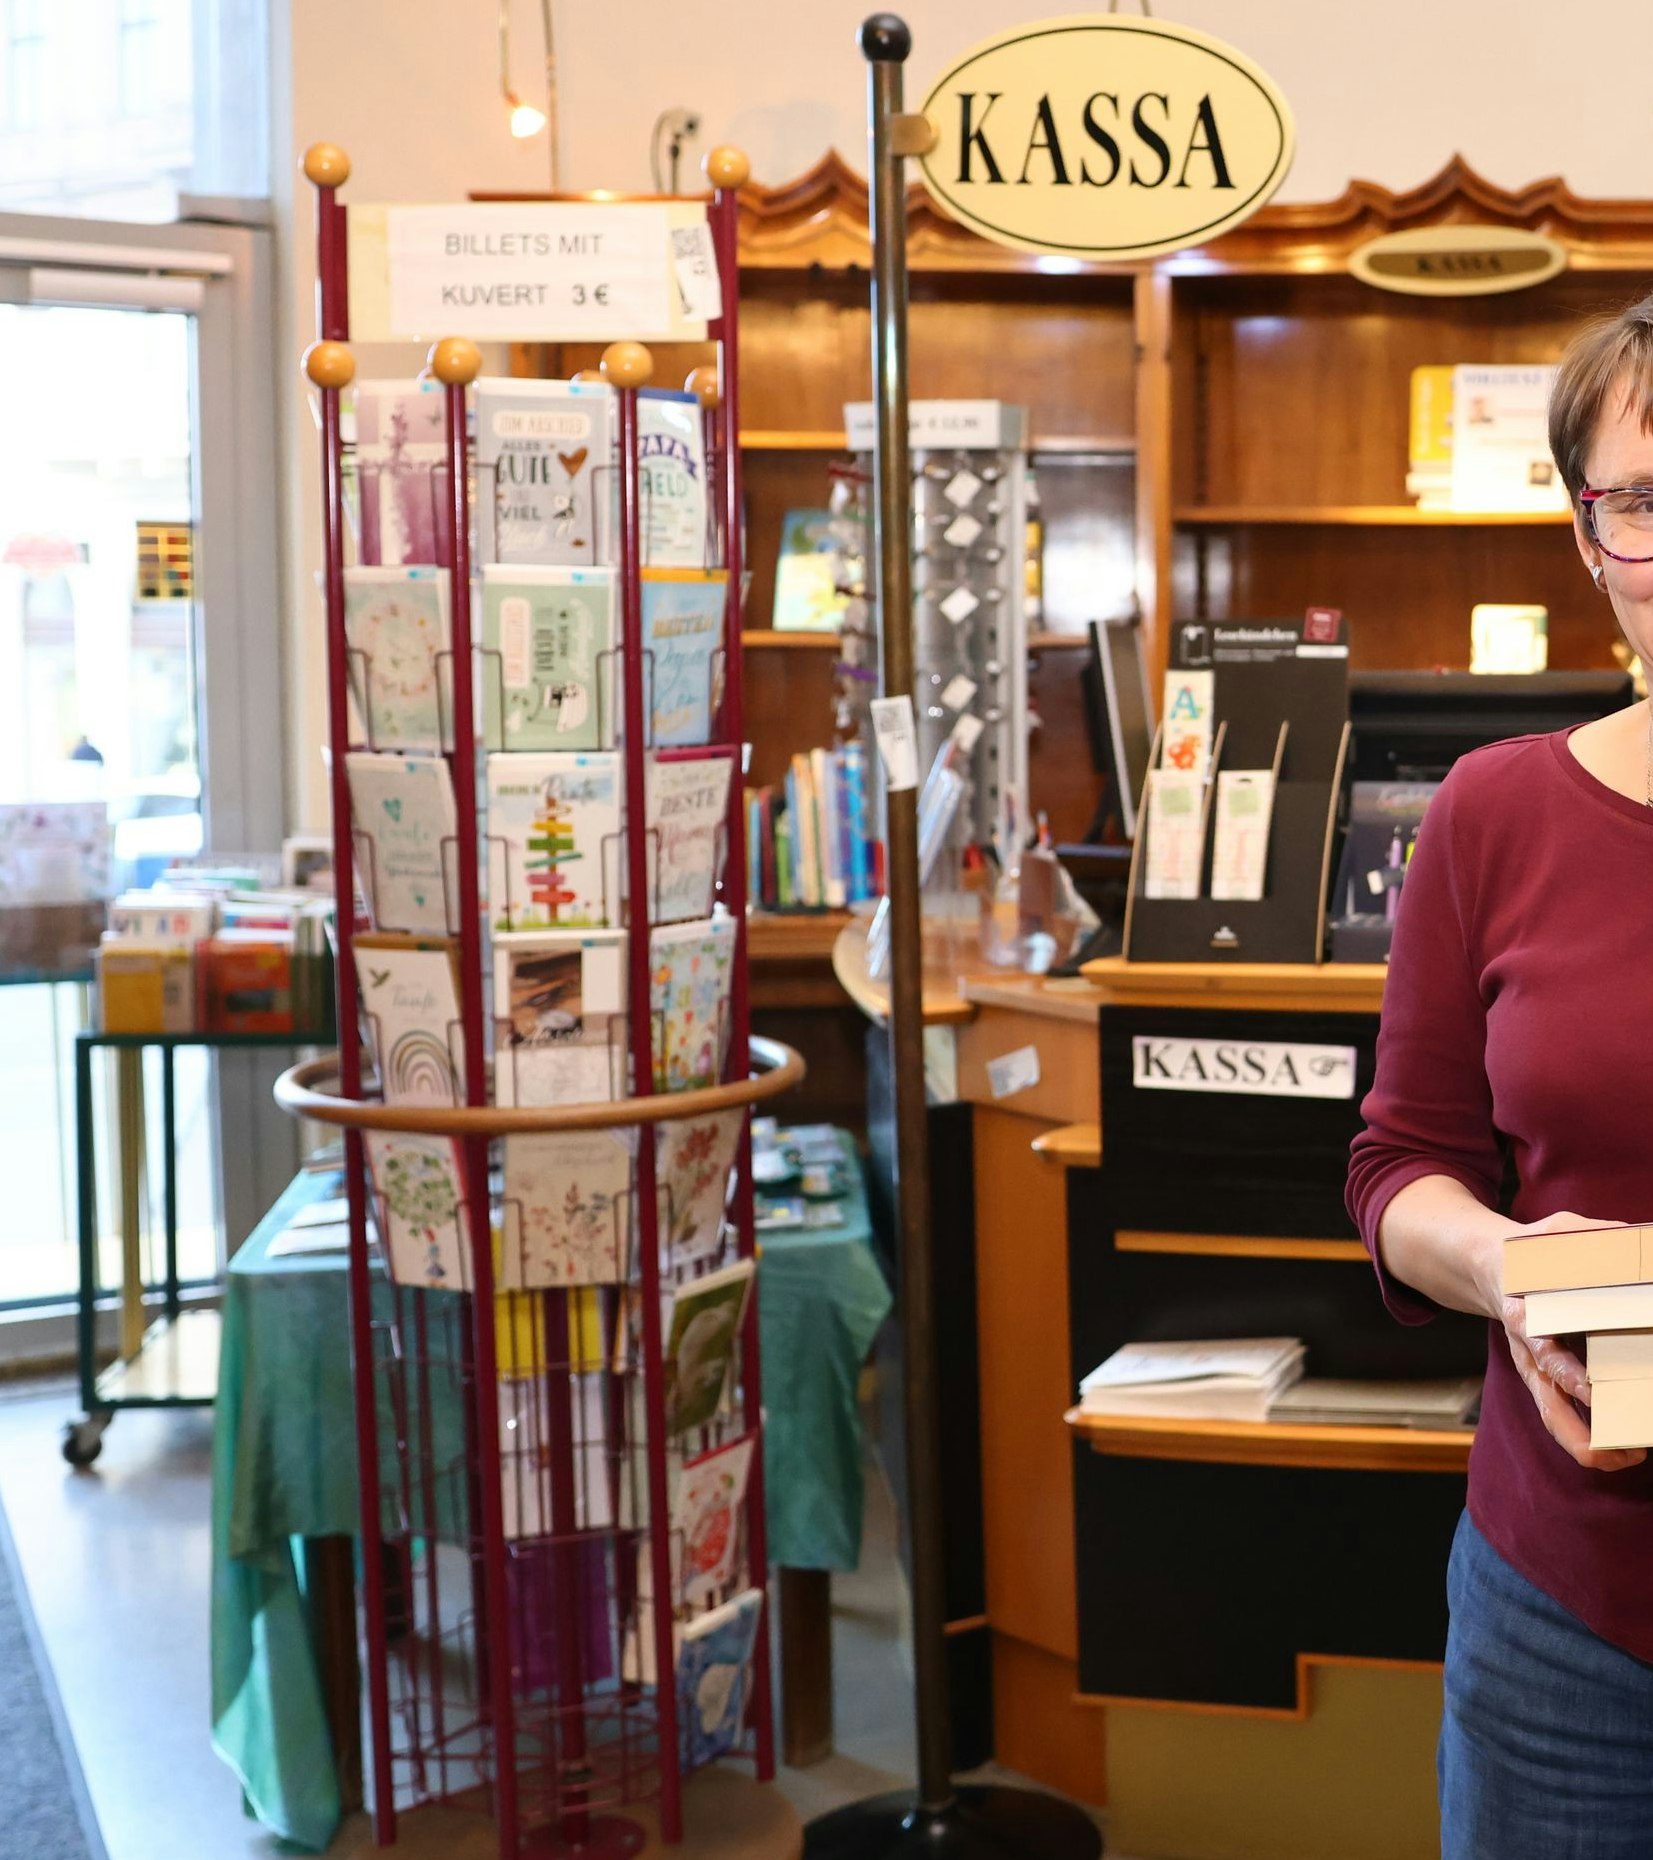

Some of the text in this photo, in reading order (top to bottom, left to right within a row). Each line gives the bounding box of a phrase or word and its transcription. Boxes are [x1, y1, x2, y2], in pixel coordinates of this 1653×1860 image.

[954, 91, 1238, 190] KASSA
[444, 232, 604, 257] BILLETS MIT
[441, 283, 611, 306] KUVERT 3 €
[499, 505, 542, 522] VIEL
[1138, 1042, 1303, 1087] KASSA
